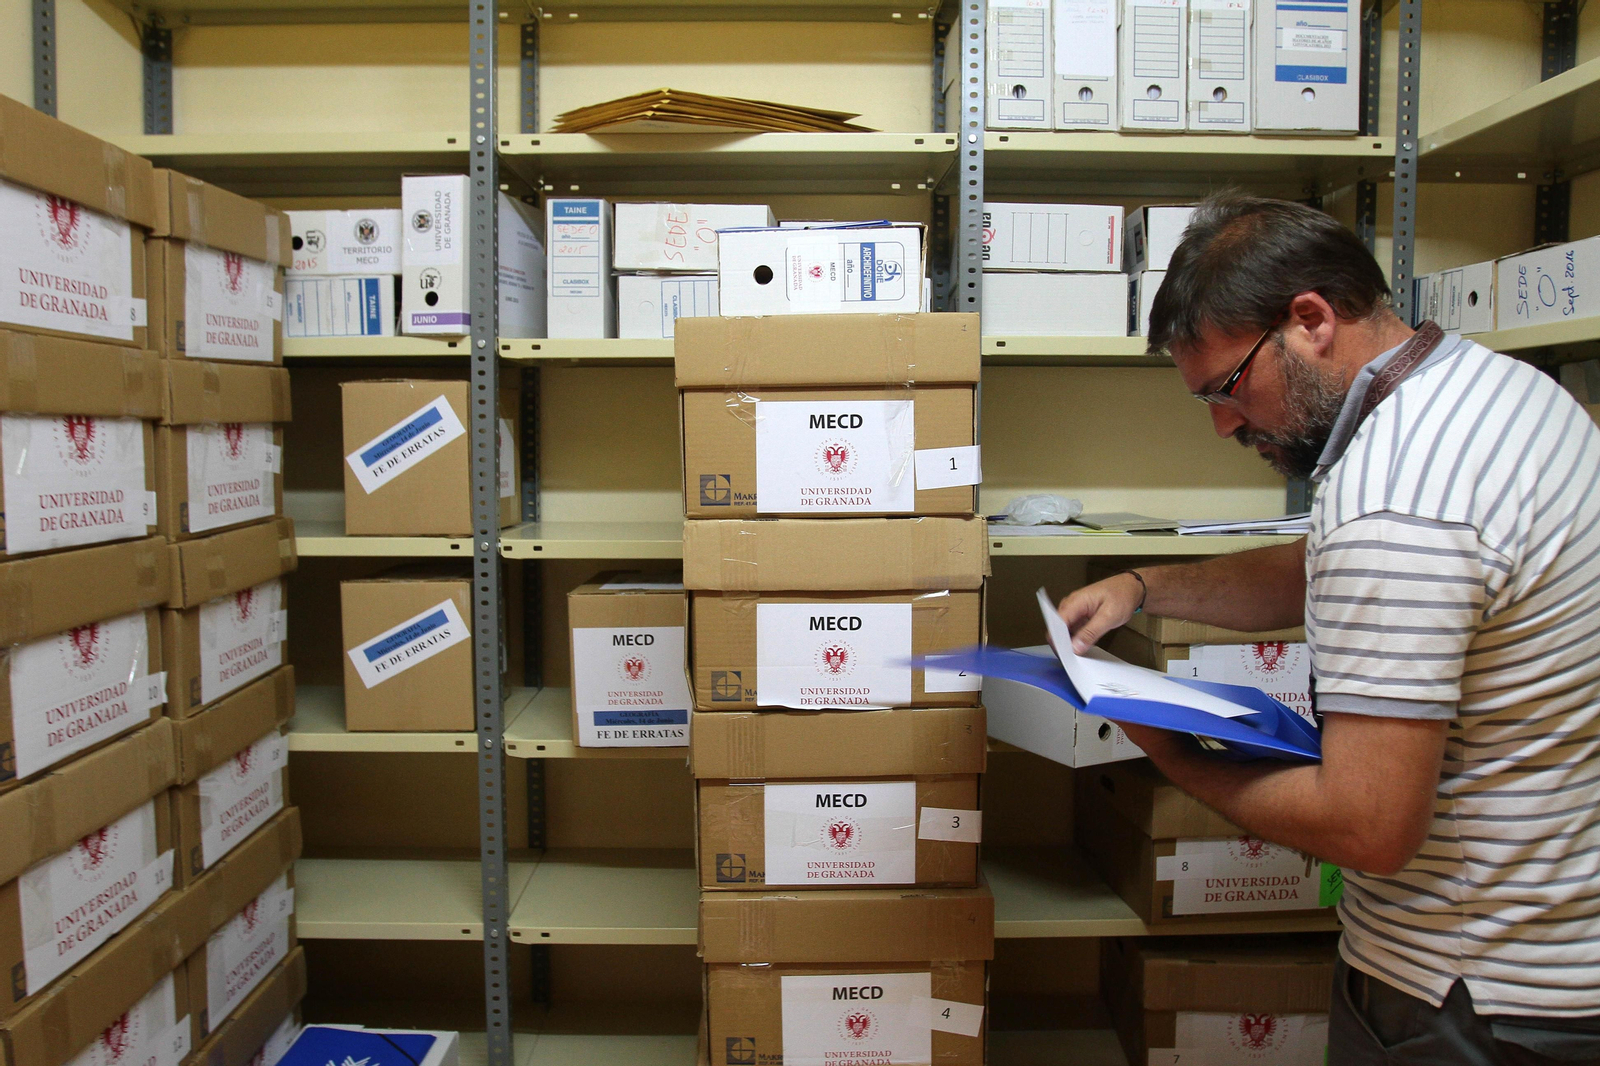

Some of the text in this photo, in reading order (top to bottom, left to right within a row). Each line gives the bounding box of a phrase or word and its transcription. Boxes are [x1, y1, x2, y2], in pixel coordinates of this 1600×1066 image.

[564, 206, 587, 214] TAINE
[556, 224, 586, 234] SEDE
[444, 236, 451, 249] DE
[664, 212, 688, 263] SEDE
[342, 246, 392, 255] TERRITORIO
[295, 257, 318, 271] 2015
[356, 257, 379, 265] MECD
[847, 259, 855, 274] año
[876, 259, 884, 283] DOHE
[18, 268, 108, 300] UNIVERSIDAD
[1517, 264, 1530, 319] SEDE
[20, 291, 109, 321] DE GRANADA
[369, 294, 377, 320] TAINE
[130, 307, 136, 322] 8
[413, 315, 438, 325] JUNIO
[205, 313, 259, 332] UNIVERSIDAD
[206, 331, 259, 349] DE GRANADA
[809, 414, 864, 429] MECD
[372, 425, 446, 478] FE DE ERRATAS
[949, 457, 958, 471] 1
[207, 478, 260, 497] UNIVERSIDAD
[800, 487, 872, 496] UNIVERSIDAD
[38, 489, 124, 510] UNIVERSIDAD
[208, 494, 260, 515] DE GRANADA
[800, 496, 872, 506] DE GRANADA
[40, 508, 125, 533] DE GRANADA
[809, 616, 863, 631] MECD
[612, 634, 655, 647] MECD
[218, 637, 263, 666] UNIVERSIDA
[374, 628, 452, 673] FE DE ERRATAS
[219, 649, 268, 682] DE GRANADA
[1191, 666, 1198, 678] 1
[607, 690, 664, 698] UNIVERSIDAD
[800, 687, 871, 696] UNIVERSIDAD
[45, 681, 128, 725] UNIVERSIDAD
[800, 696, 870, 706] DE GRANADA
[47, 700, 129, 748] DE GRANADA
[596, 728, 685, 739] FE DE ERRATAS
[219, 781, 270, 826] UNIVERSIDAD
[815, 793, 868, 808] MECD
[231, 797, 270, 835] GRANADA
[952, 815, 960, 829] 3
[807, 861, 875, 869] UNIVERSIDAD
[1181, 861, 1189, 872] 8
[807, 870, 875, 879] DE GRANADA
[1205, 875, 1300, 889] UNIVERSIDAD
[54, 871, 137, 935] UNIVERSIDAD
[1204, 889, 1299, 903] DE GRANADA
[57, 890, 139, 958] DE GRANADA
[832, 986, 884, 1001] MECD
[941, 1007, 951, 1019] 4
[824, 1050, 892, 1059] UNIVERSIDAD
[1173, 1054, 1181, 1064] 7
